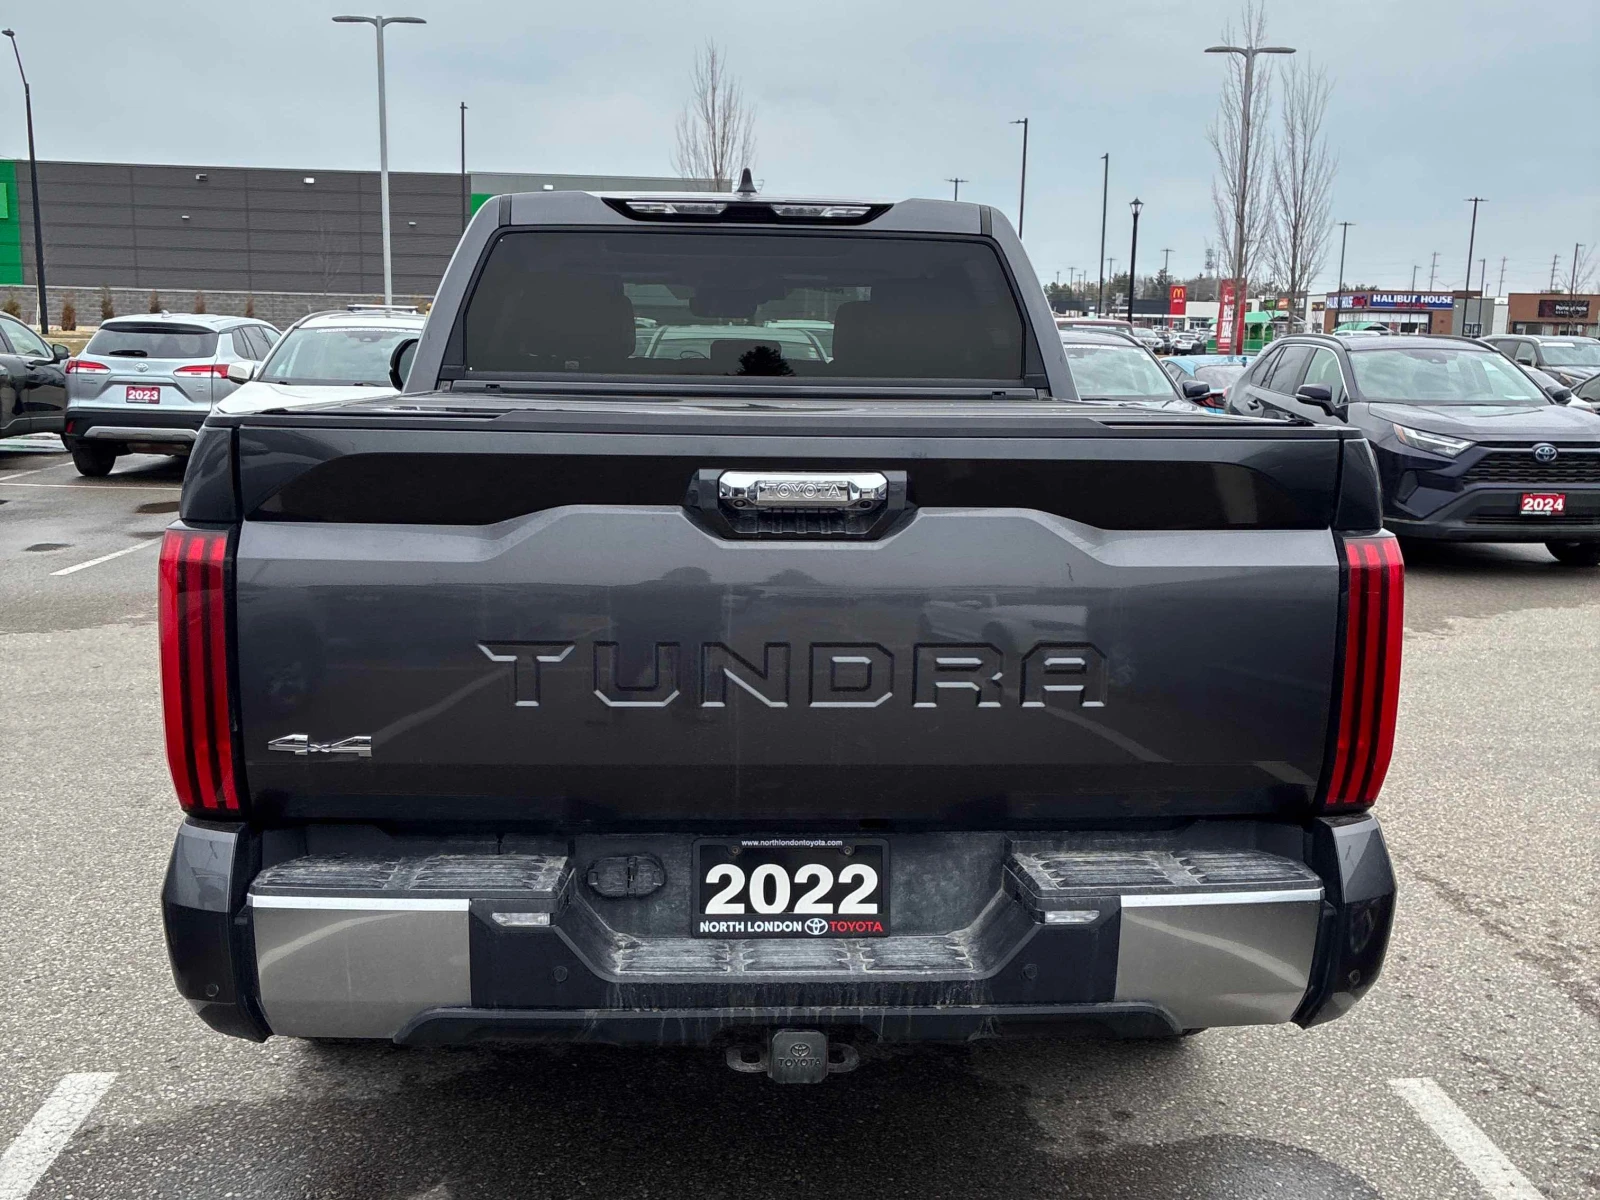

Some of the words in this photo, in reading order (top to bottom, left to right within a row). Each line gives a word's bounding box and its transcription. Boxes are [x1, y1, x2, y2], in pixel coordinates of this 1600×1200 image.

[1373, 294, 1417, 304] HALIBUT
[1420, 295, 1453, 304] HOUSE
[128, 390, 158, 400] 2023
[765, 483, 841, 498] TOYOTA
[1523, 498, 1564, 511] 2024
[477, 640, 1107, 707] TUNDRA
[741, 839, 843, 848] www.northlondontoyota.com
[705, 863, 878, 914] 2022
[700, 921, 744, 932] NORTH
[747, 921, 802, 932] LONDON
[830, 921, 883, 932] TOYOTA
[778, 1058, 821, 1067] TOYOTA
